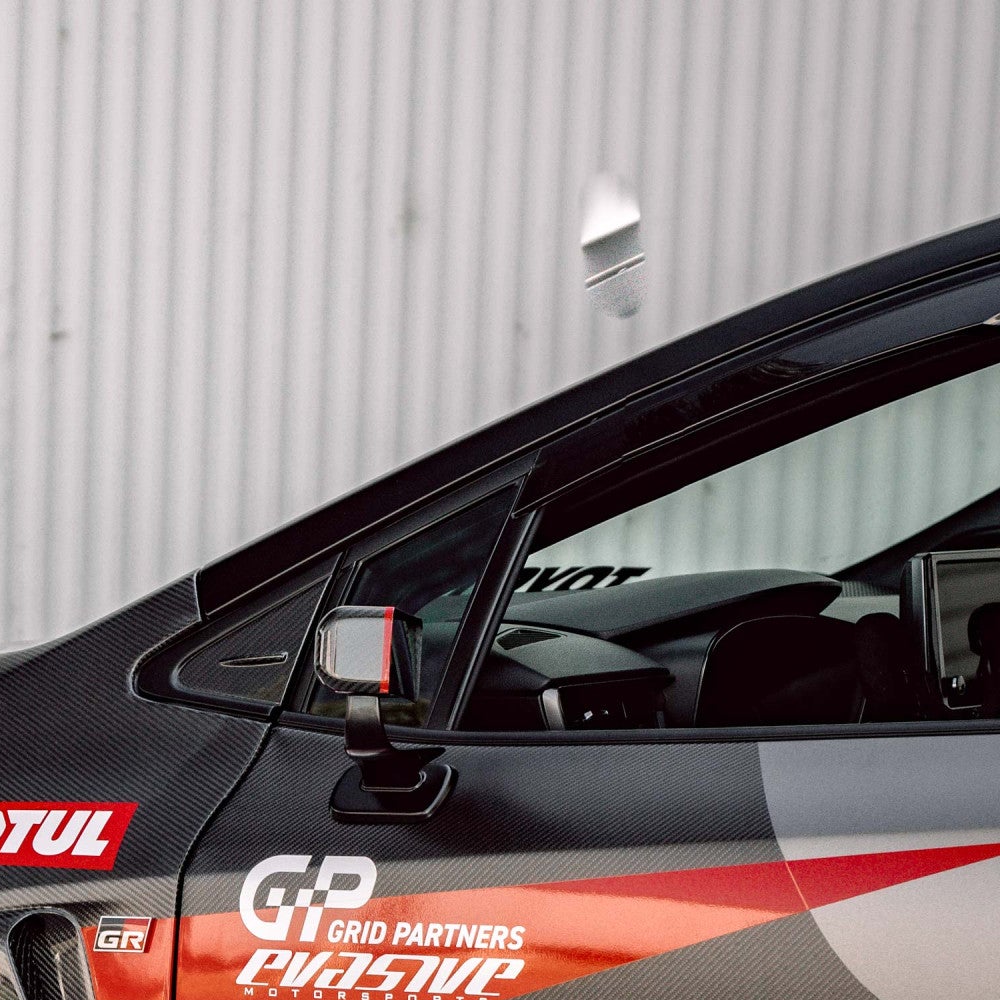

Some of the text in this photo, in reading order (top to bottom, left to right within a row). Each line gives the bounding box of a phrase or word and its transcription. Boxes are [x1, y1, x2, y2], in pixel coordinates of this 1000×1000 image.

[239, 855, 377, 942] GP
[97, 931, 144, 950] GR
[327, 919, 526, 950] GRID PARTNERS
